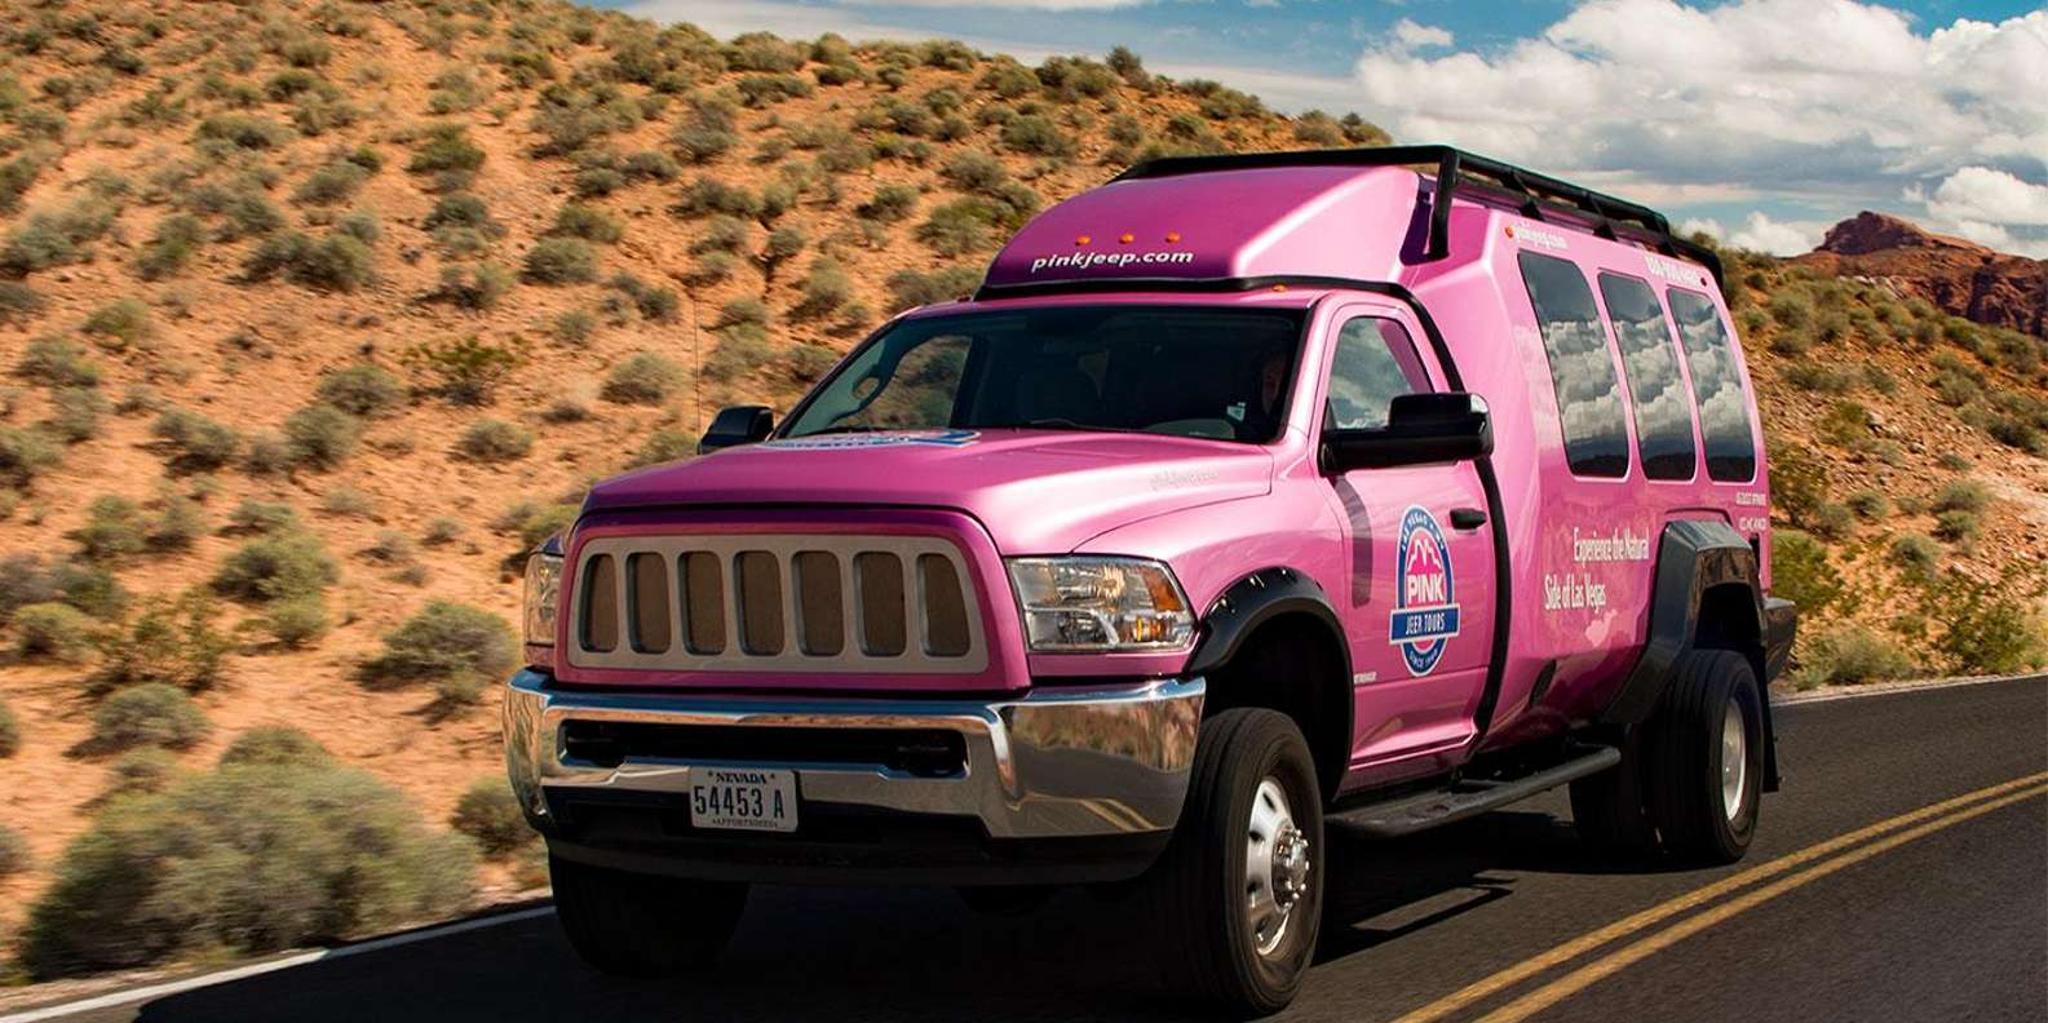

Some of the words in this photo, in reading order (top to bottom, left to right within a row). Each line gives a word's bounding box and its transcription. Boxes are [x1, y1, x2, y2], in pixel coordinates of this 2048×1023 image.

[1031, 251, 1194, 273] pinkjeep.com
[1573, 526, 1612, 568] Experience
[1612, 527, 1624, 560] the
[1624, 527, 1650, 560] Natural
[1407, 573, 1445, 604] PINK
[1544, 573, 1561, 610] Side
[1561, 573, 1571, 609] of
[1571, 573, 1584, 608] Las
[1584, 572, 1606, 614] Vegas
[1424, 612, 1446, 633] TOURS
[716, 772, 767, 784] NEVADA
[694, 785, 763, 818] 54453
[773, 789, 784, 819] A
